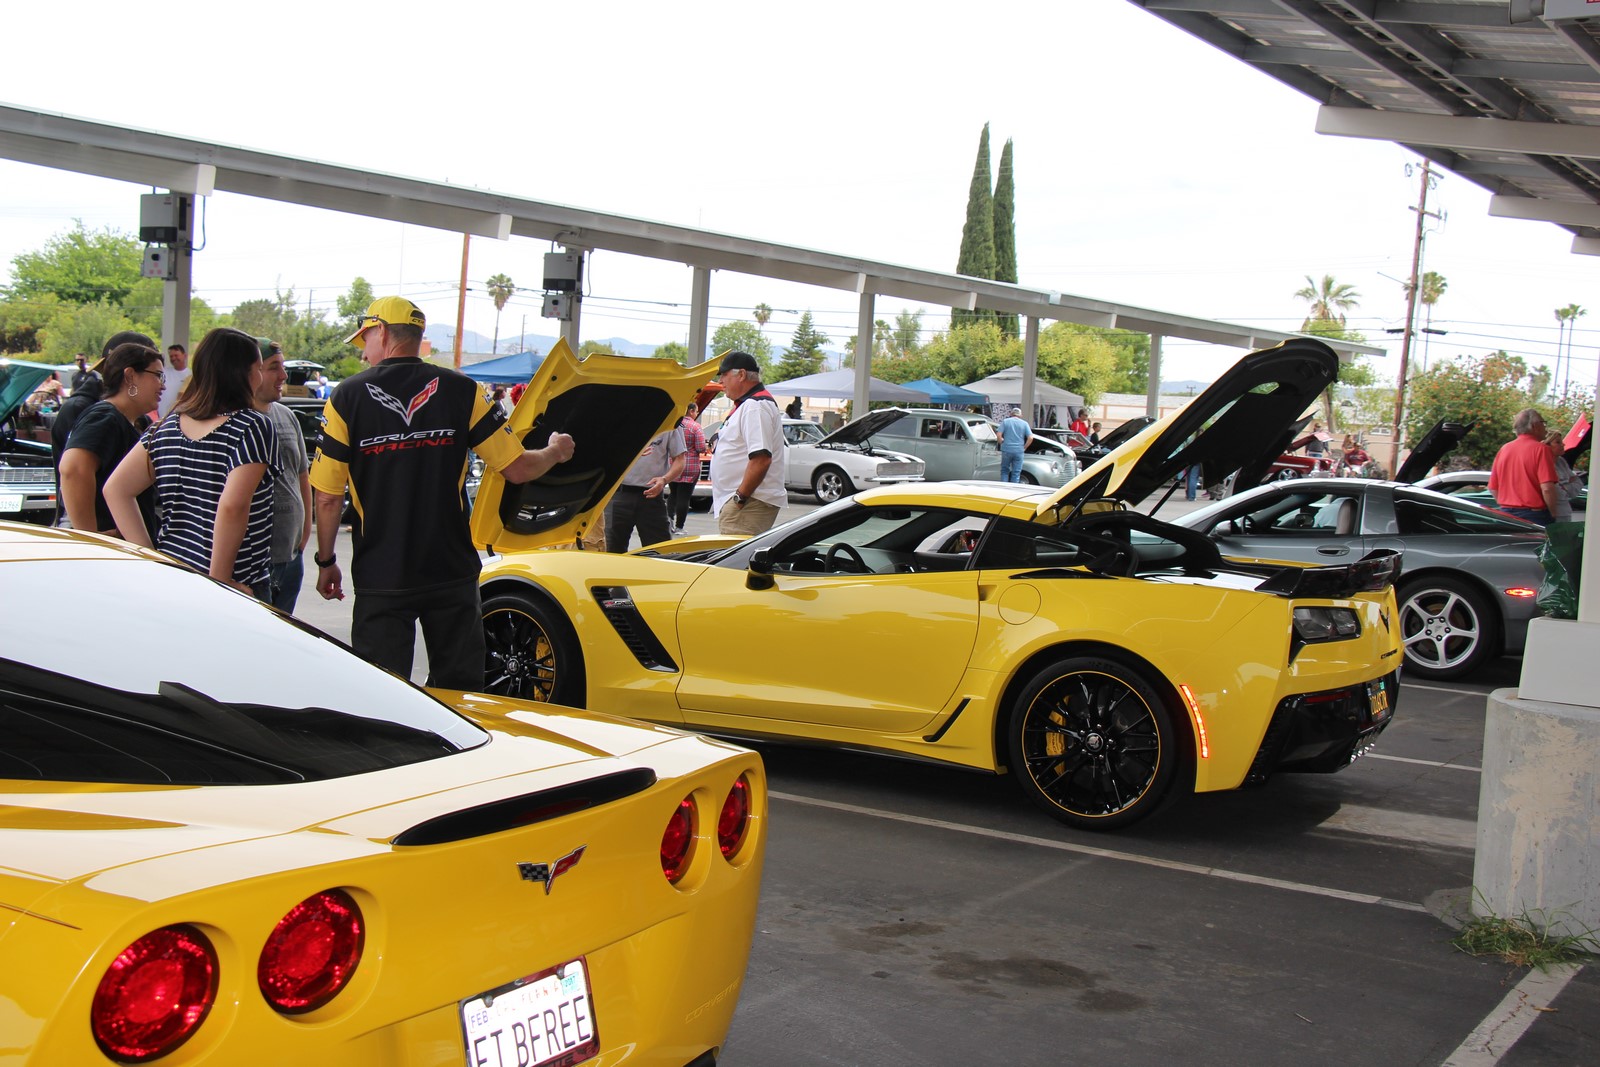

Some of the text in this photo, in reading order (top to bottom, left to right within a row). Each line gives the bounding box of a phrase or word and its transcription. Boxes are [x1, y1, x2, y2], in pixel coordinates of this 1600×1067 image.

[360, 429, 456, 447] CORVETTE
[360, 437, 456, 456] RACING
[470, 1010, 489, 1029] FEB
[511, 995, 591, 1067] BFREE
